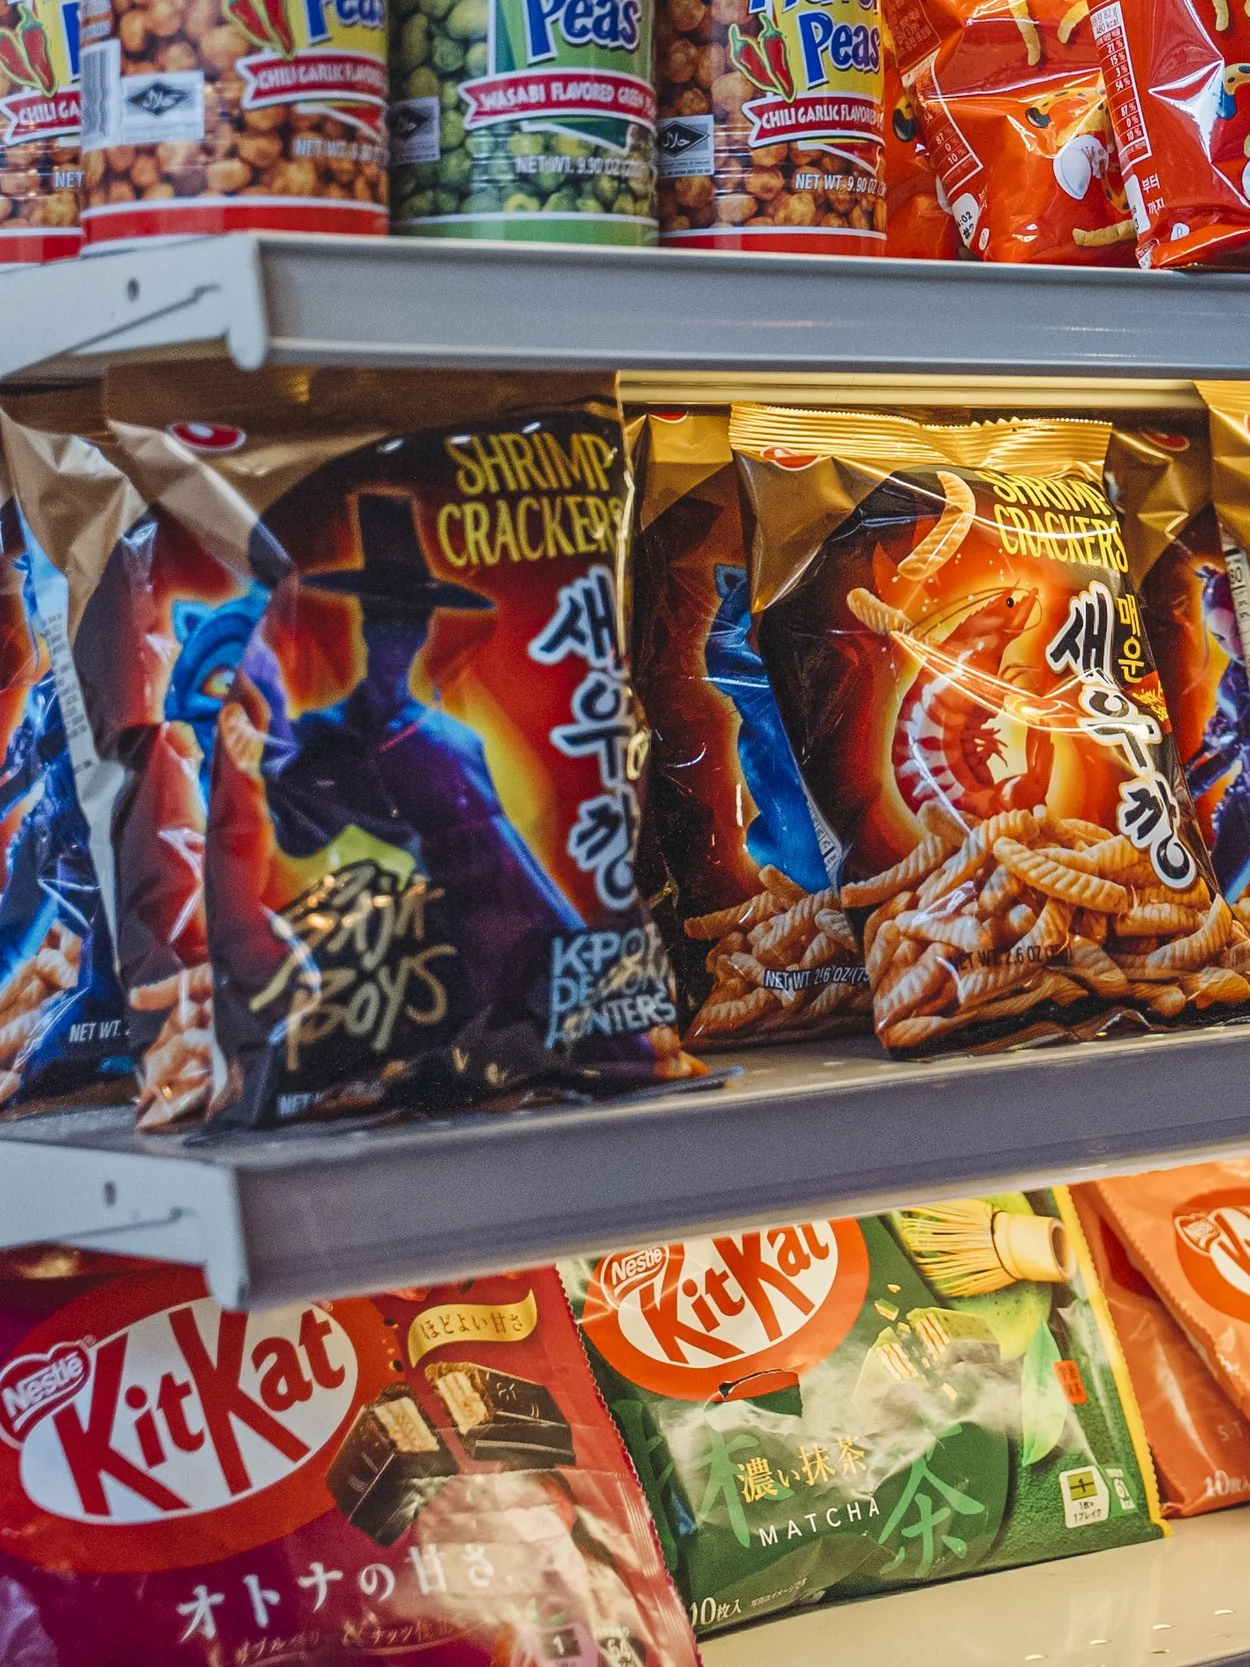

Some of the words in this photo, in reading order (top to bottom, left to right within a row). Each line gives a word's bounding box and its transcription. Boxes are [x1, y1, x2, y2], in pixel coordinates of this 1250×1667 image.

[796, 9, 880, 89] Peas
[255, 66, 298, 90] CHILI
[480, 81, 546, 111] WASABI
[550, 78, 614, 103] FLAVORED
[18, 102, 57, 126] CHILI
[761, 102, 796, 130] CHILI
[797, 100, 839, 125] GARLIC
[54, 169, 83, 188] NET
[516, 153, 547, 175] NET
[795, 172, 820, 191] NET
[822, 174, 844, 191] WT.
[846, 176, 866, 192] 9.90
[1141, 173, 1161, 193] 부터
[1147, 196, 1166, 216] 까지
[445, 432, 617, 495] SHRIMP
[980, 471, 1111, 516] SHRIMP
[993, 503, 1129, 573] CRACKERS
[1115, 593, 1145, 684] 매운
[530, 564, 643, 911] 새우깡
[1046, 580, 1198, 892] 새우깡
[1027, 945, 1042, 963] OZ
[764, 969, 789, 989] NET
[793, 969, 809, 988] WT
[69, 1022, 98, 1044] NET
[637, 1217, 830, 1367] KitKat
[420, 1312, 523, 1341] ほどよい甘さ
[2, 1350, 85, 1417] Nestlé
[53, 1305, 347, 1517] KitKat
[736, 1436, 867, 1503] 濃い抹茶
[758, 1497, 881, 1547] MATCHA
[177, 1541, 497, 1645] オトナの甘さ
